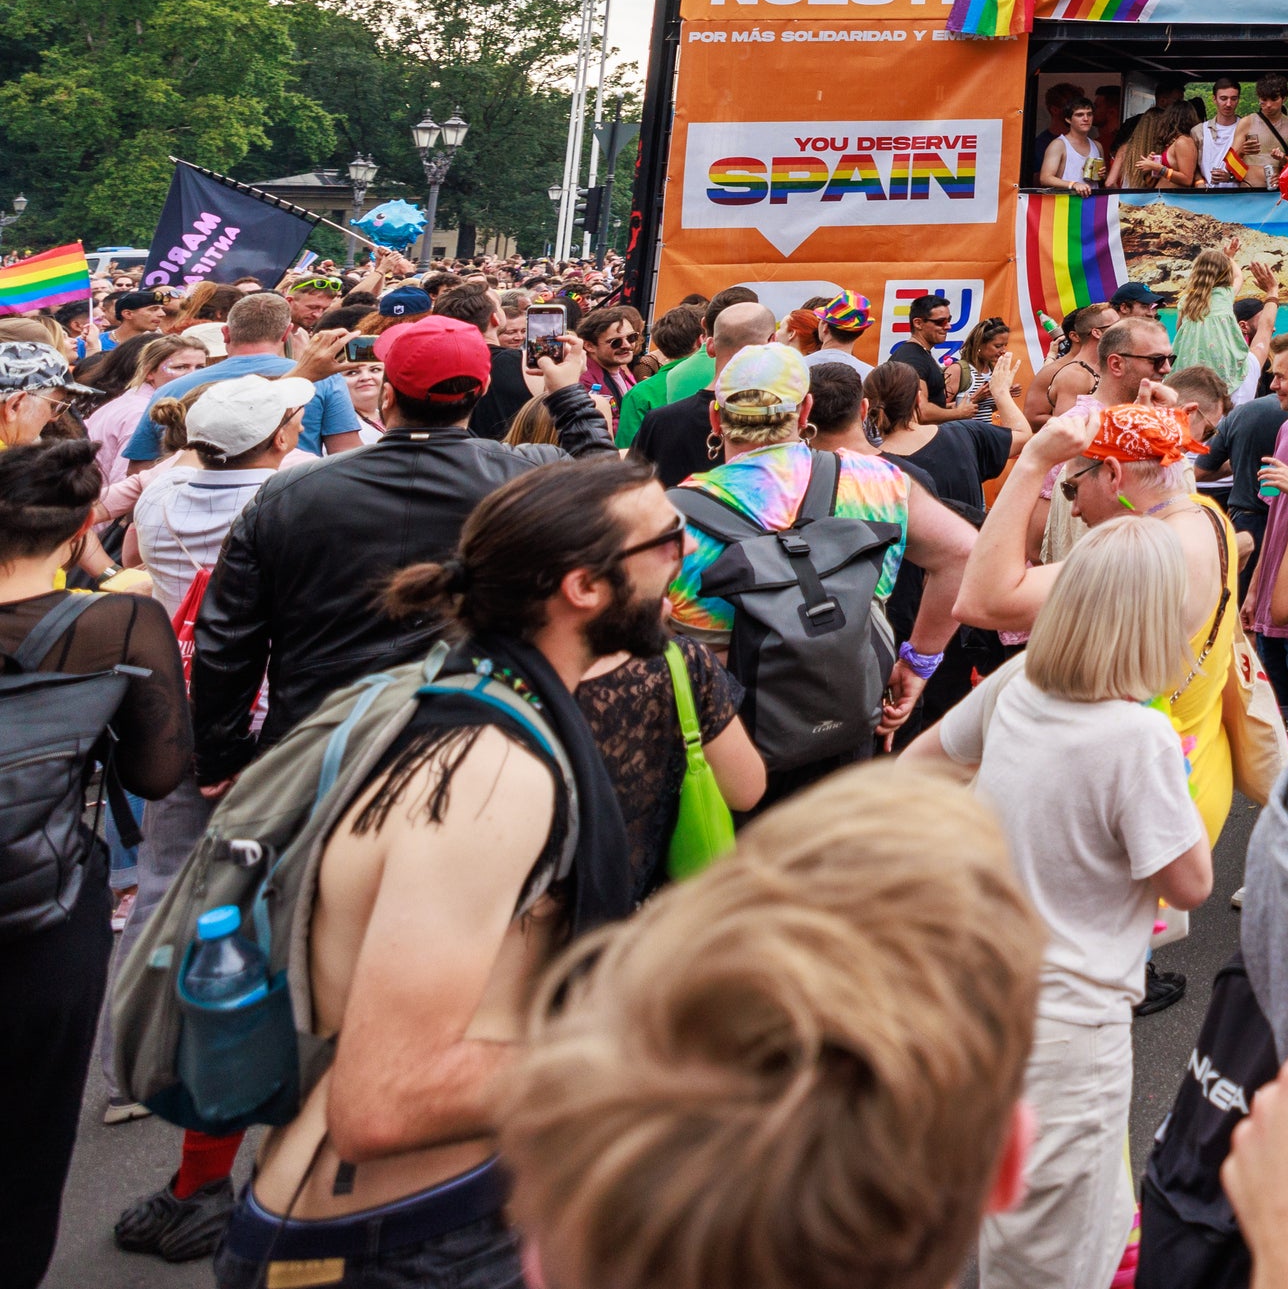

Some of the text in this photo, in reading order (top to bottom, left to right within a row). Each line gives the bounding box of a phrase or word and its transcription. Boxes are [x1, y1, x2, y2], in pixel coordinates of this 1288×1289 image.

[688, 30, 726, 43] POR
[731, 28, 776, 43] MÁS
[781, 30, 908, 43] SOLIDARIDAD
[913, 30, 927, 41] Y
[794, 135, 977, 152] YOU DESERVE
[706, 152, 977, 206] SPAIN
